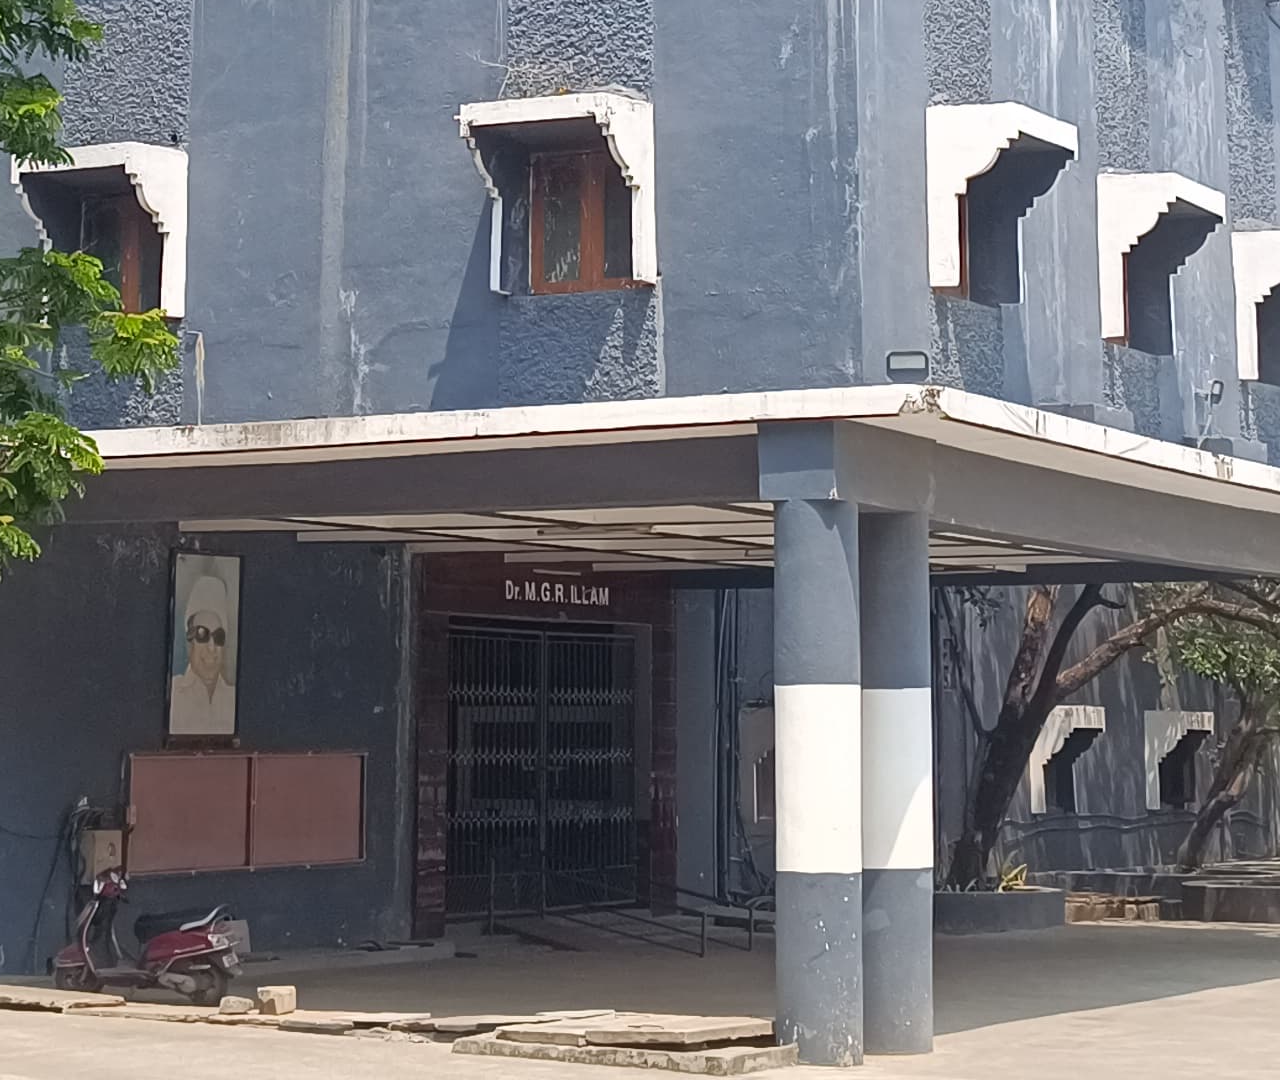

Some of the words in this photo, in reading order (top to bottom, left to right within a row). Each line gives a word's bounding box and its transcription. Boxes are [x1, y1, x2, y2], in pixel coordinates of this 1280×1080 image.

[505, 580, 522, 600] Dr.
[525, 581, 568, 603] M.G.R.
[570, 584, 609, 606] ILLAM
